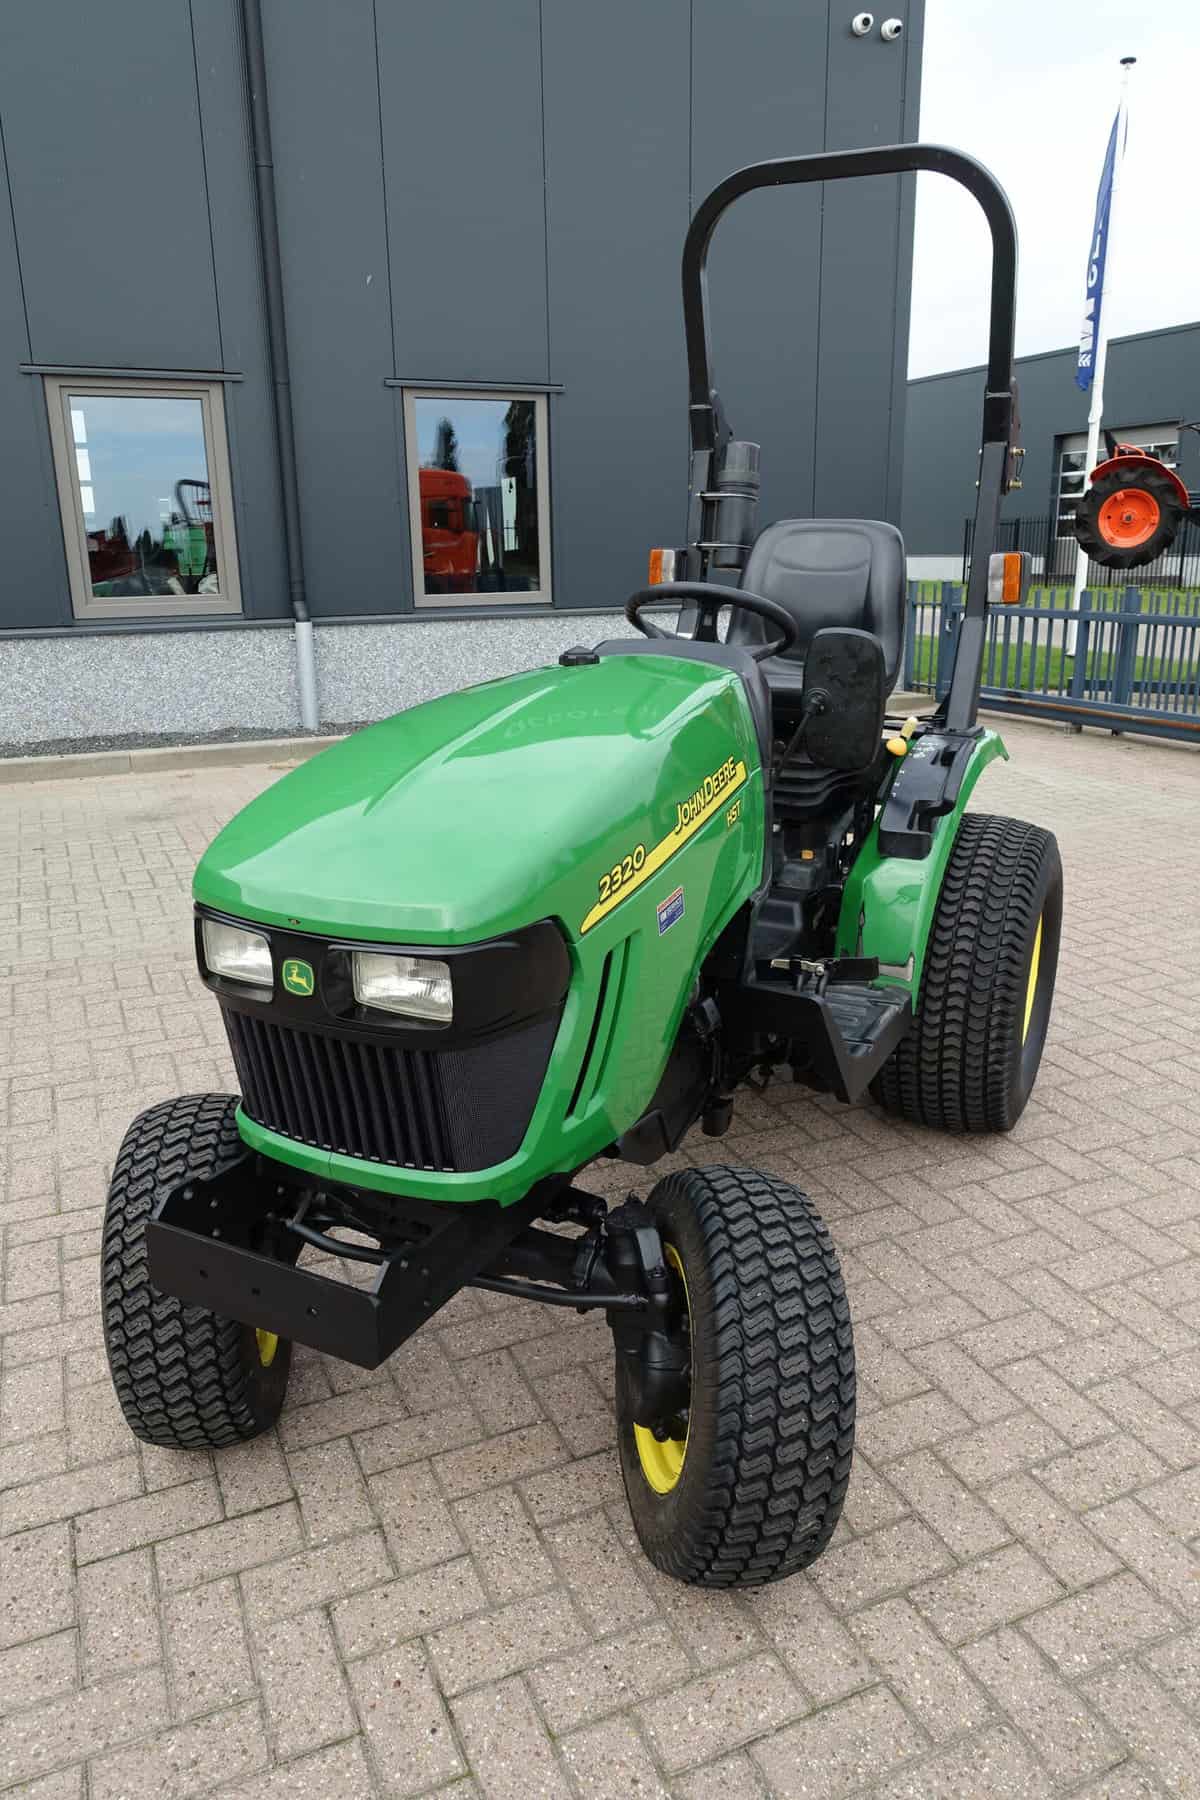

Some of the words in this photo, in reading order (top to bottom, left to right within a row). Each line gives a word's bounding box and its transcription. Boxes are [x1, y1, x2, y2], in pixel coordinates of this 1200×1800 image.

[674, 787, 705, 834] JOHN
[703, 755, 737, 805] DEERE
[727, 799, 741, 827] HST
[599, 844, 645, 904] 2320
